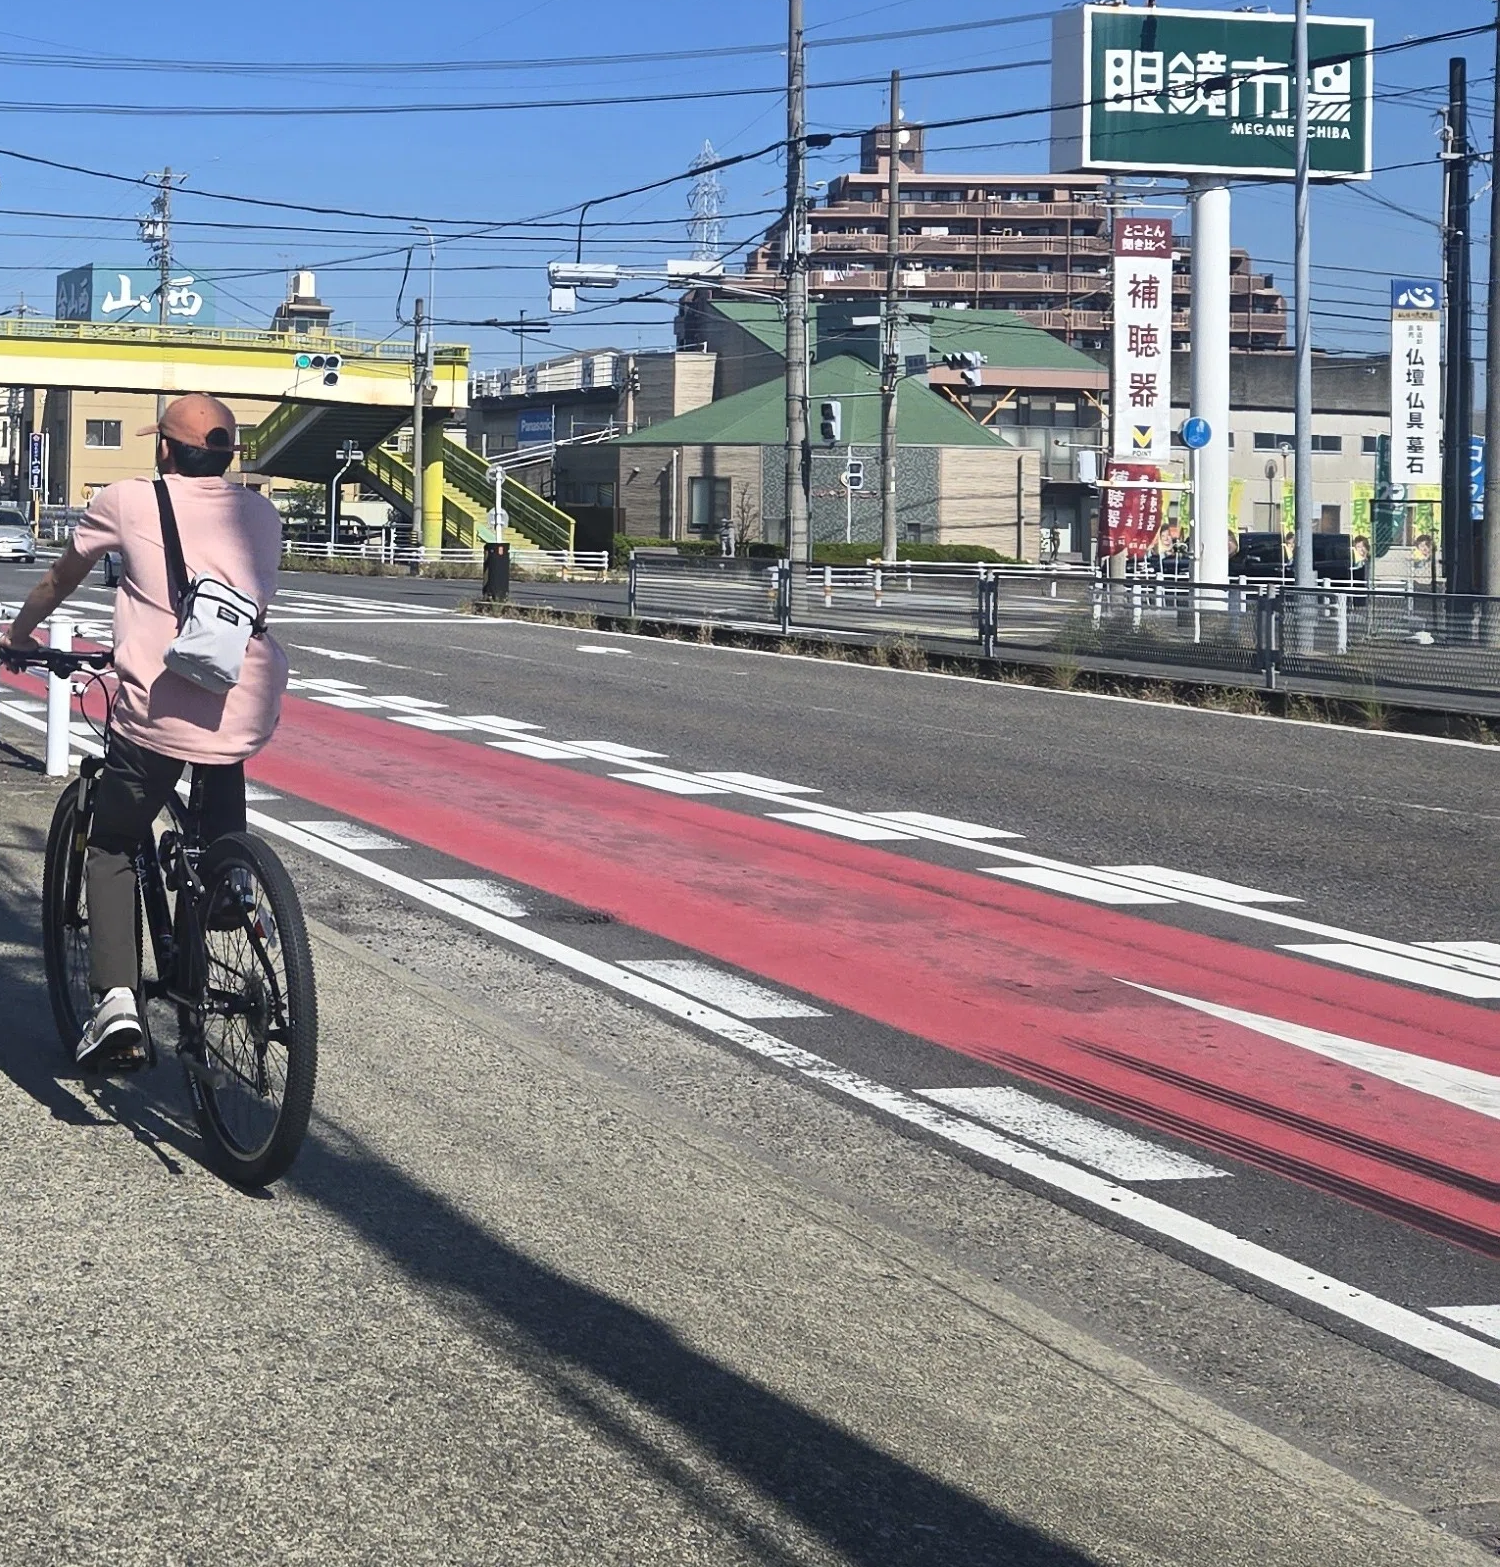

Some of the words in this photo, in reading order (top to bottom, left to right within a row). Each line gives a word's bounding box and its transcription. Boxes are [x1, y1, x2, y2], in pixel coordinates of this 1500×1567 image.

[1230, 121, 1295, 139] MEGANE
[1303, 124, 1351, 140] CHIBA
[1123, 224, 1166, 238] とことん
[1121, 238, 1167, 251] 聞き比べ
[1398, 287, 1435, 308] 心
[1126, 273, 1161, 408] 補聴器
[520, 417, 553, 433] Panasonic
